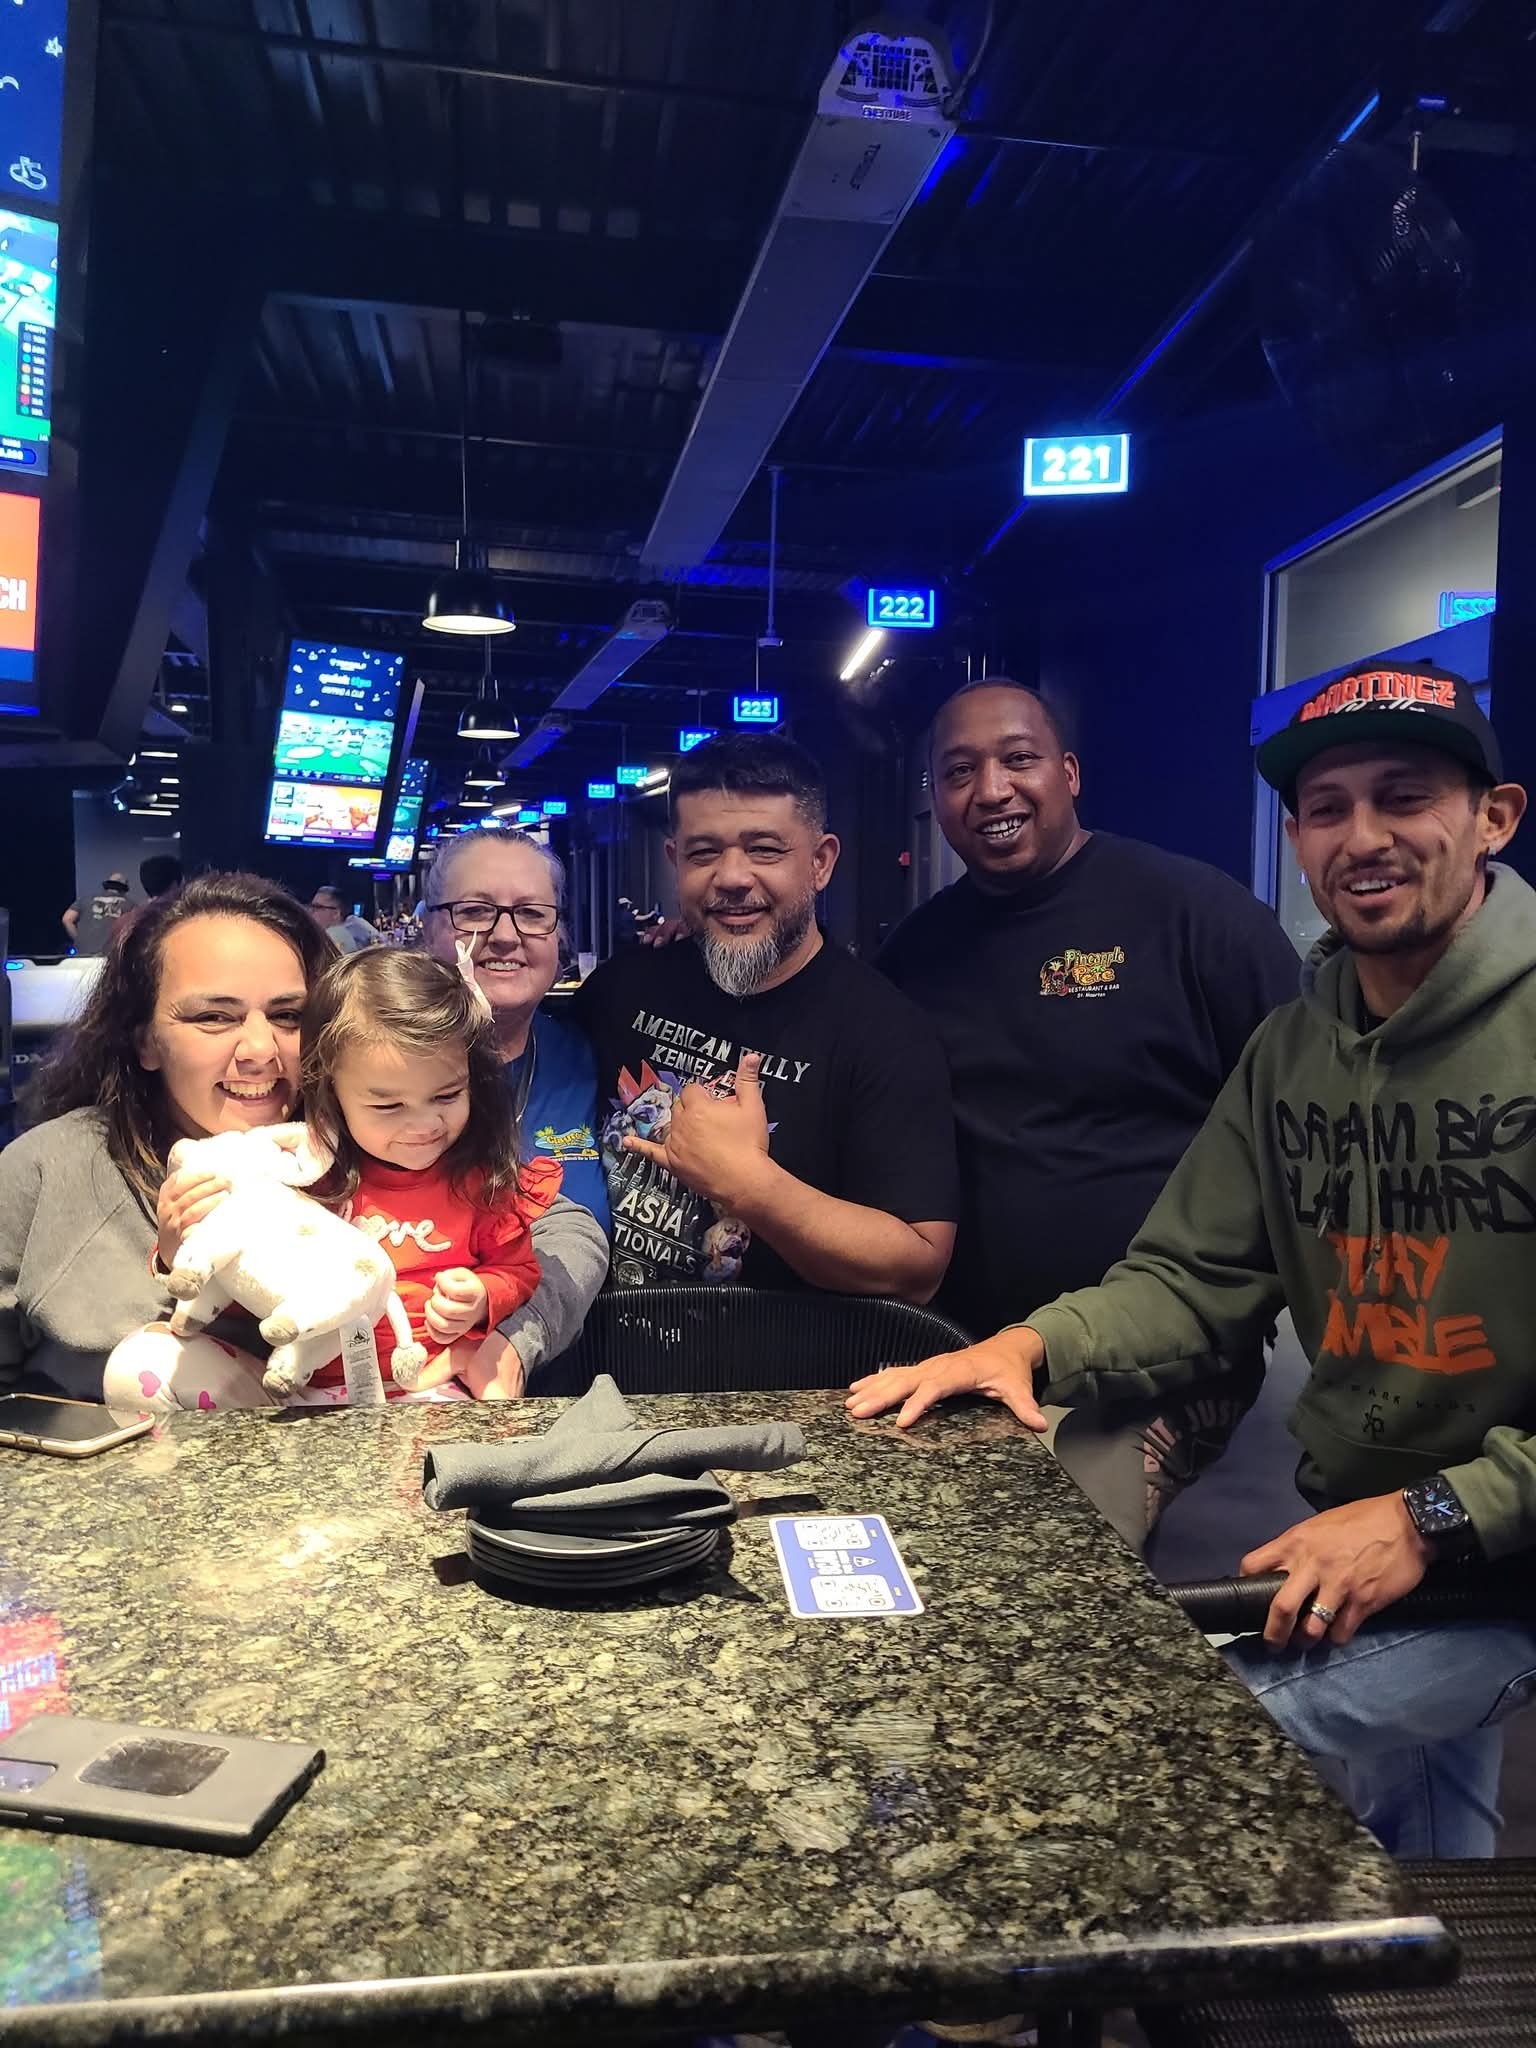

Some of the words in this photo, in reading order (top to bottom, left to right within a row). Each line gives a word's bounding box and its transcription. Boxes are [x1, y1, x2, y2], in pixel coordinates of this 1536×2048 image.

[1042, 445, 1111, 482] 221
[879, 596, 925, 619] 222
[740, 700, 772, 717] 223
[1300, 671, 1457, 722] MARTINEZ
[1065, 946, 1125, 970] Pineapple
[632, 1010, 732, 1063] AMERICAN
[738, 1046, 811, 1083] LLY
[650, 1042, 714, 1080] KENNEL
[617, 1188, 684, 1238] ASIA
[615, 1221, 696, 1273] TIONALS
